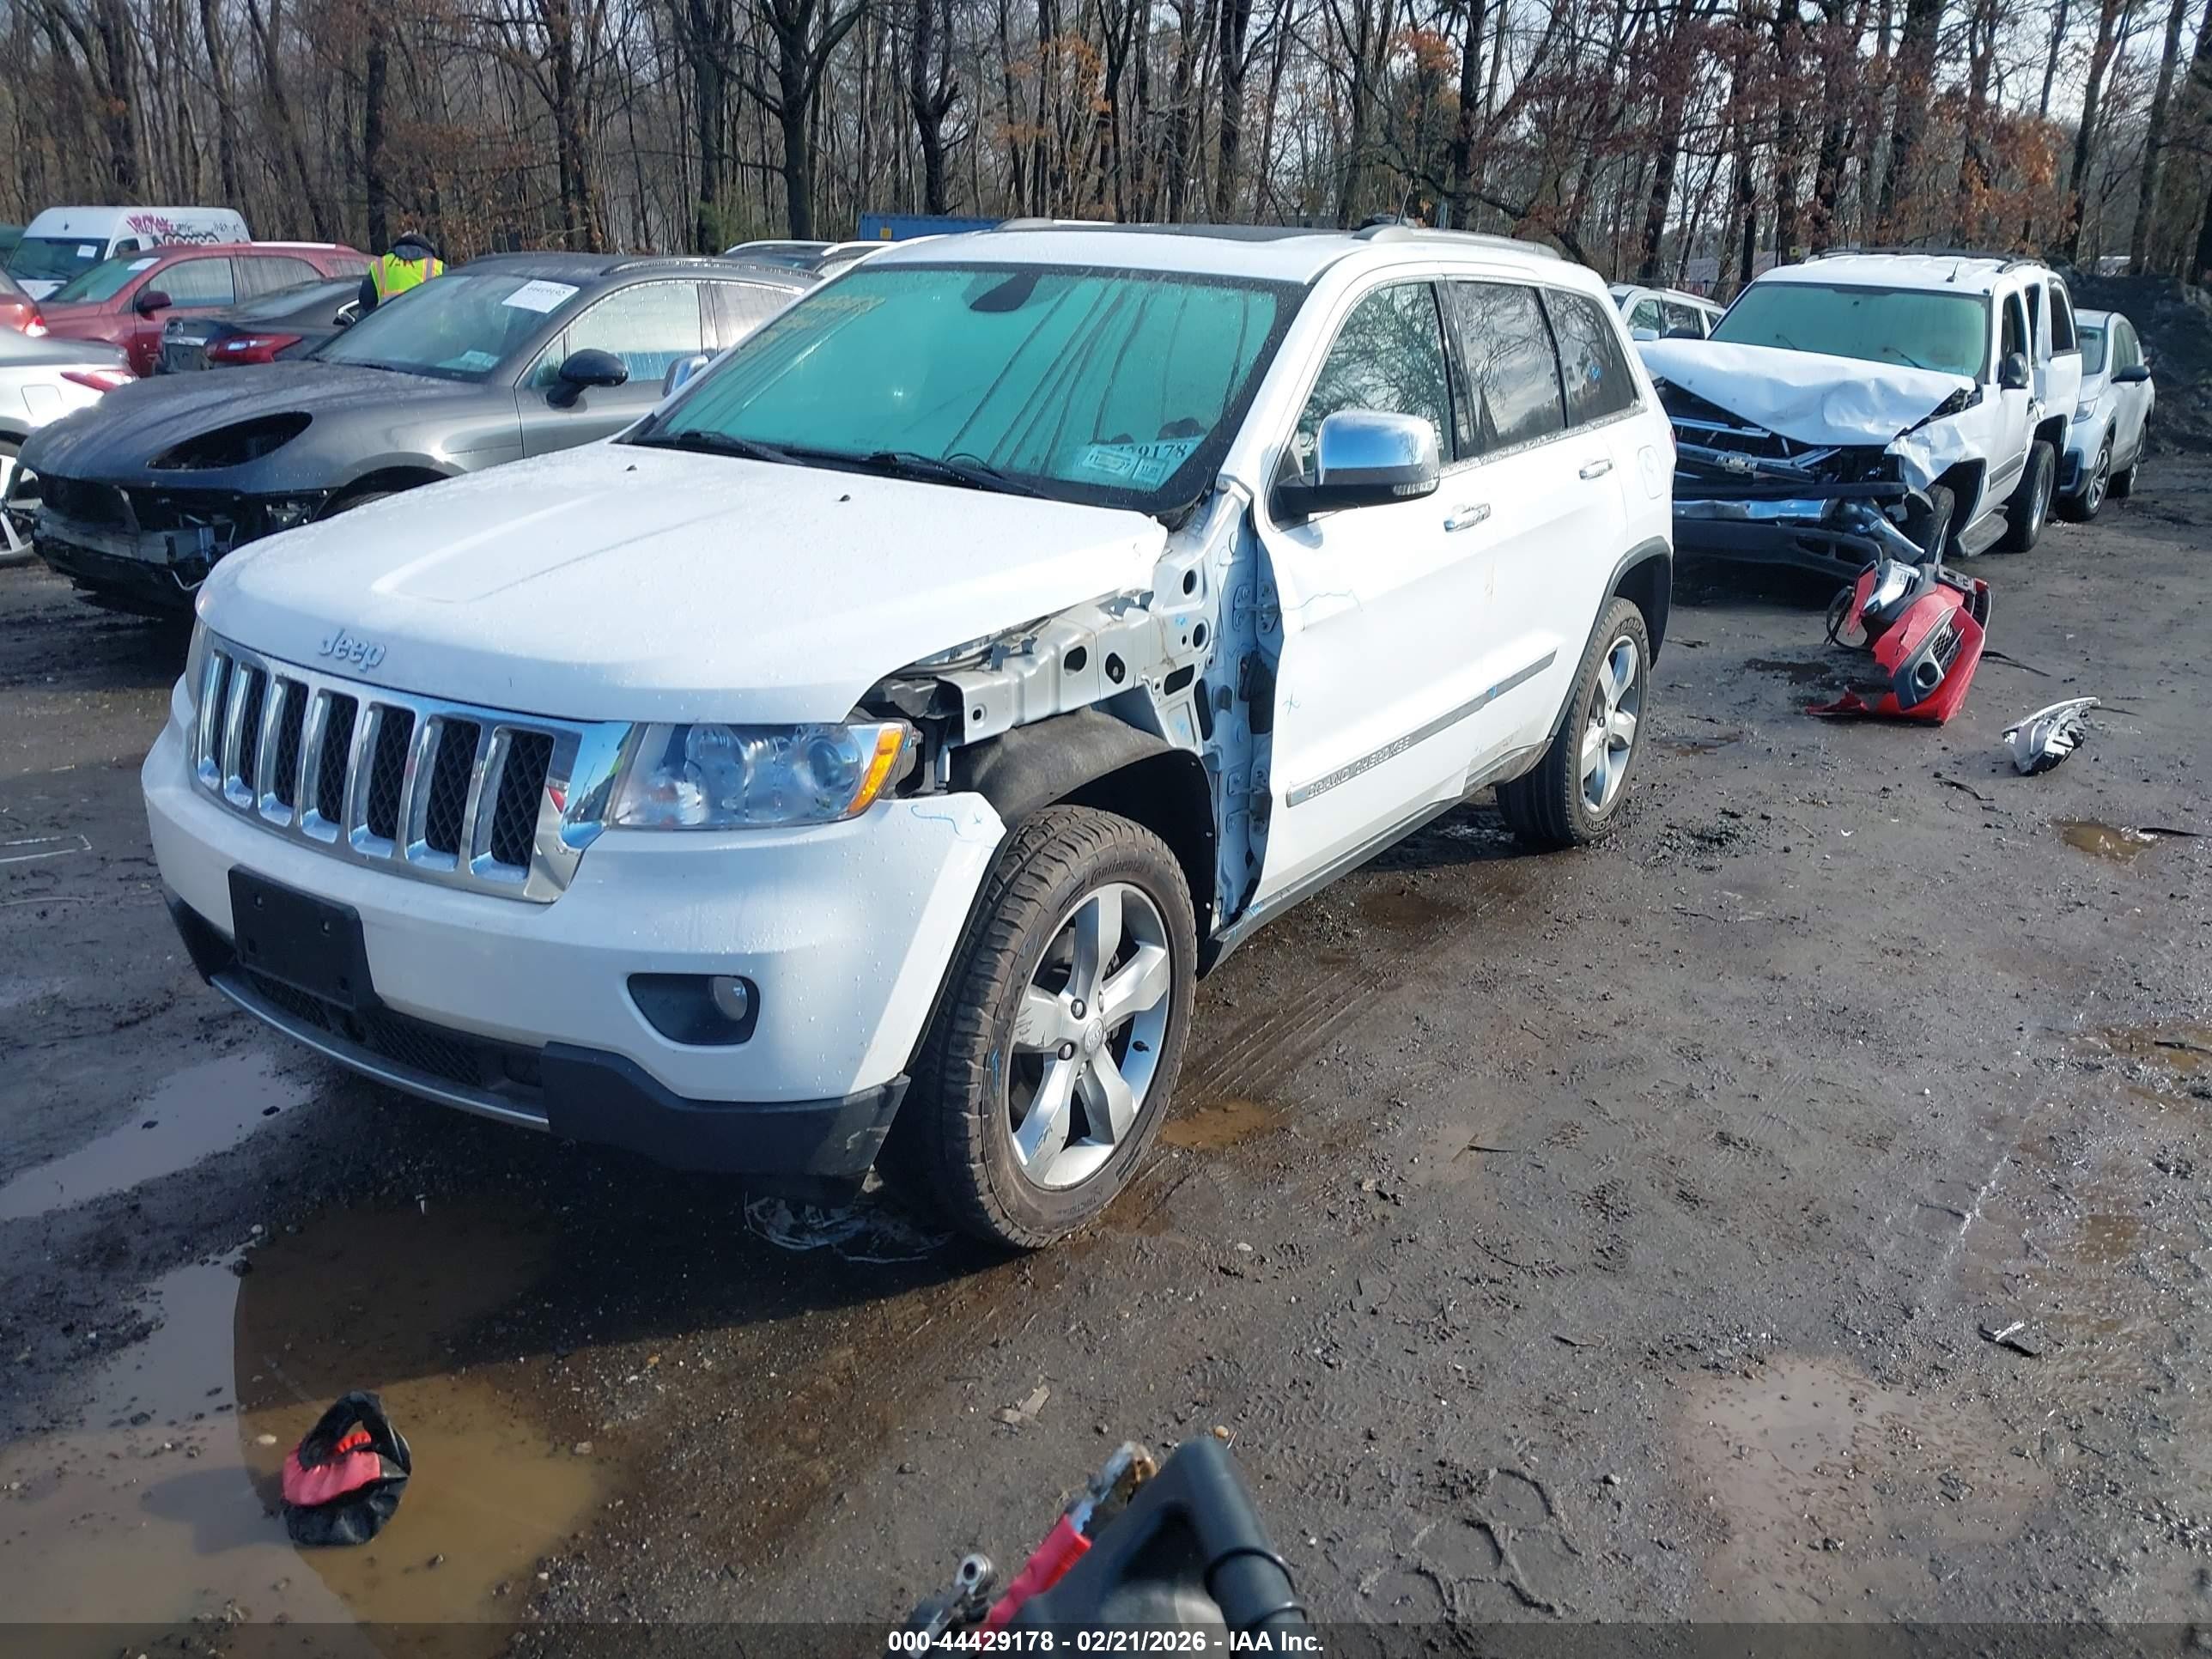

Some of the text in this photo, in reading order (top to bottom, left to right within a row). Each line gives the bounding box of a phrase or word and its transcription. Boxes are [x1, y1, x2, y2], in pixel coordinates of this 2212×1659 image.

[1120, 442, 1188, 459] 9178
[317, 629, 386, 673] Jeep
[1308, 735, 1410, 798] GRAND CHEROKEE
[1090, 860, 1146, 886] Continental
